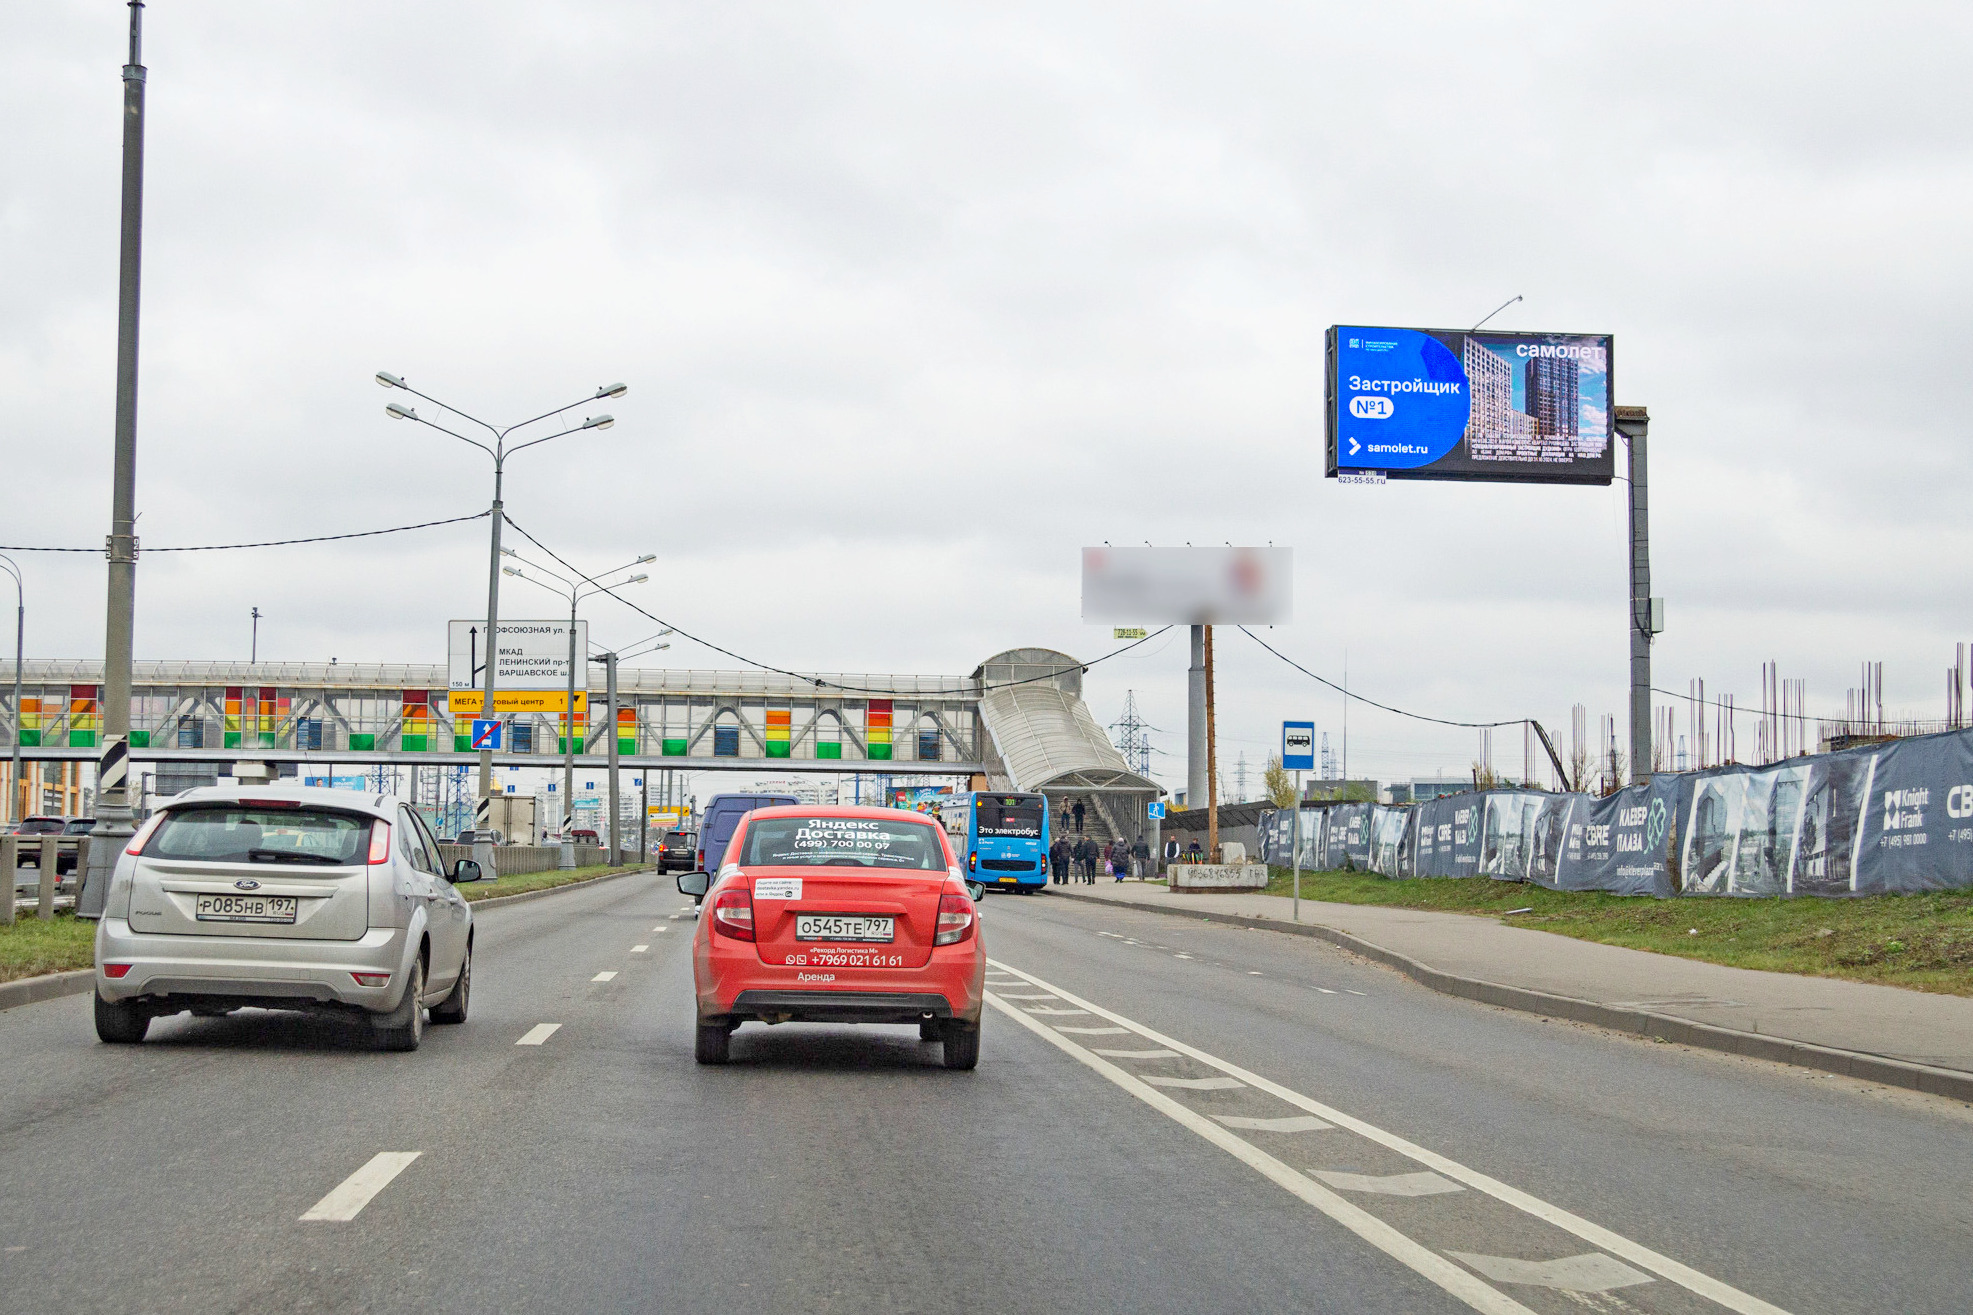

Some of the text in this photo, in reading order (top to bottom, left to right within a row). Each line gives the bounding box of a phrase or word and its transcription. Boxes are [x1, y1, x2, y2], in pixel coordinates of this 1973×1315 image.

[1516, 342, 1602, 359] самолет
[1349, 376, 1460, 395] Застройщик
[1356, 400, 1386, 414] №1
[1368, 443, 1428, 454] samolet.ru
[1338, 476, 1386, 484] 623-55-55.ru
[1902, 787, 1929, 810] Knight
[1619, 807, 1647, 827] КЛЕВЕР
[1901, 810, 1923, 828] Frank
[808, 820, 879, 829] Яндекс
[796, 829, 890, 840] Доставка
[1586, 825, 1610, 845] CBRE
[1880, 836, 1887, 847] +7
[1888, 835, 1901, 849] (495)
[1913, 833, 1926, 844] 0000
[1948, 828, 1973, 843] +7 (495)
[1617, 833, 1643, 852] ПЛАЗА
[269, 899, 291, 911] 197
[866, 919, 889, 931] 797
[812, 955, 902, 965] +7969 021 61 61
[798, 972, 835, 982] Аренда
